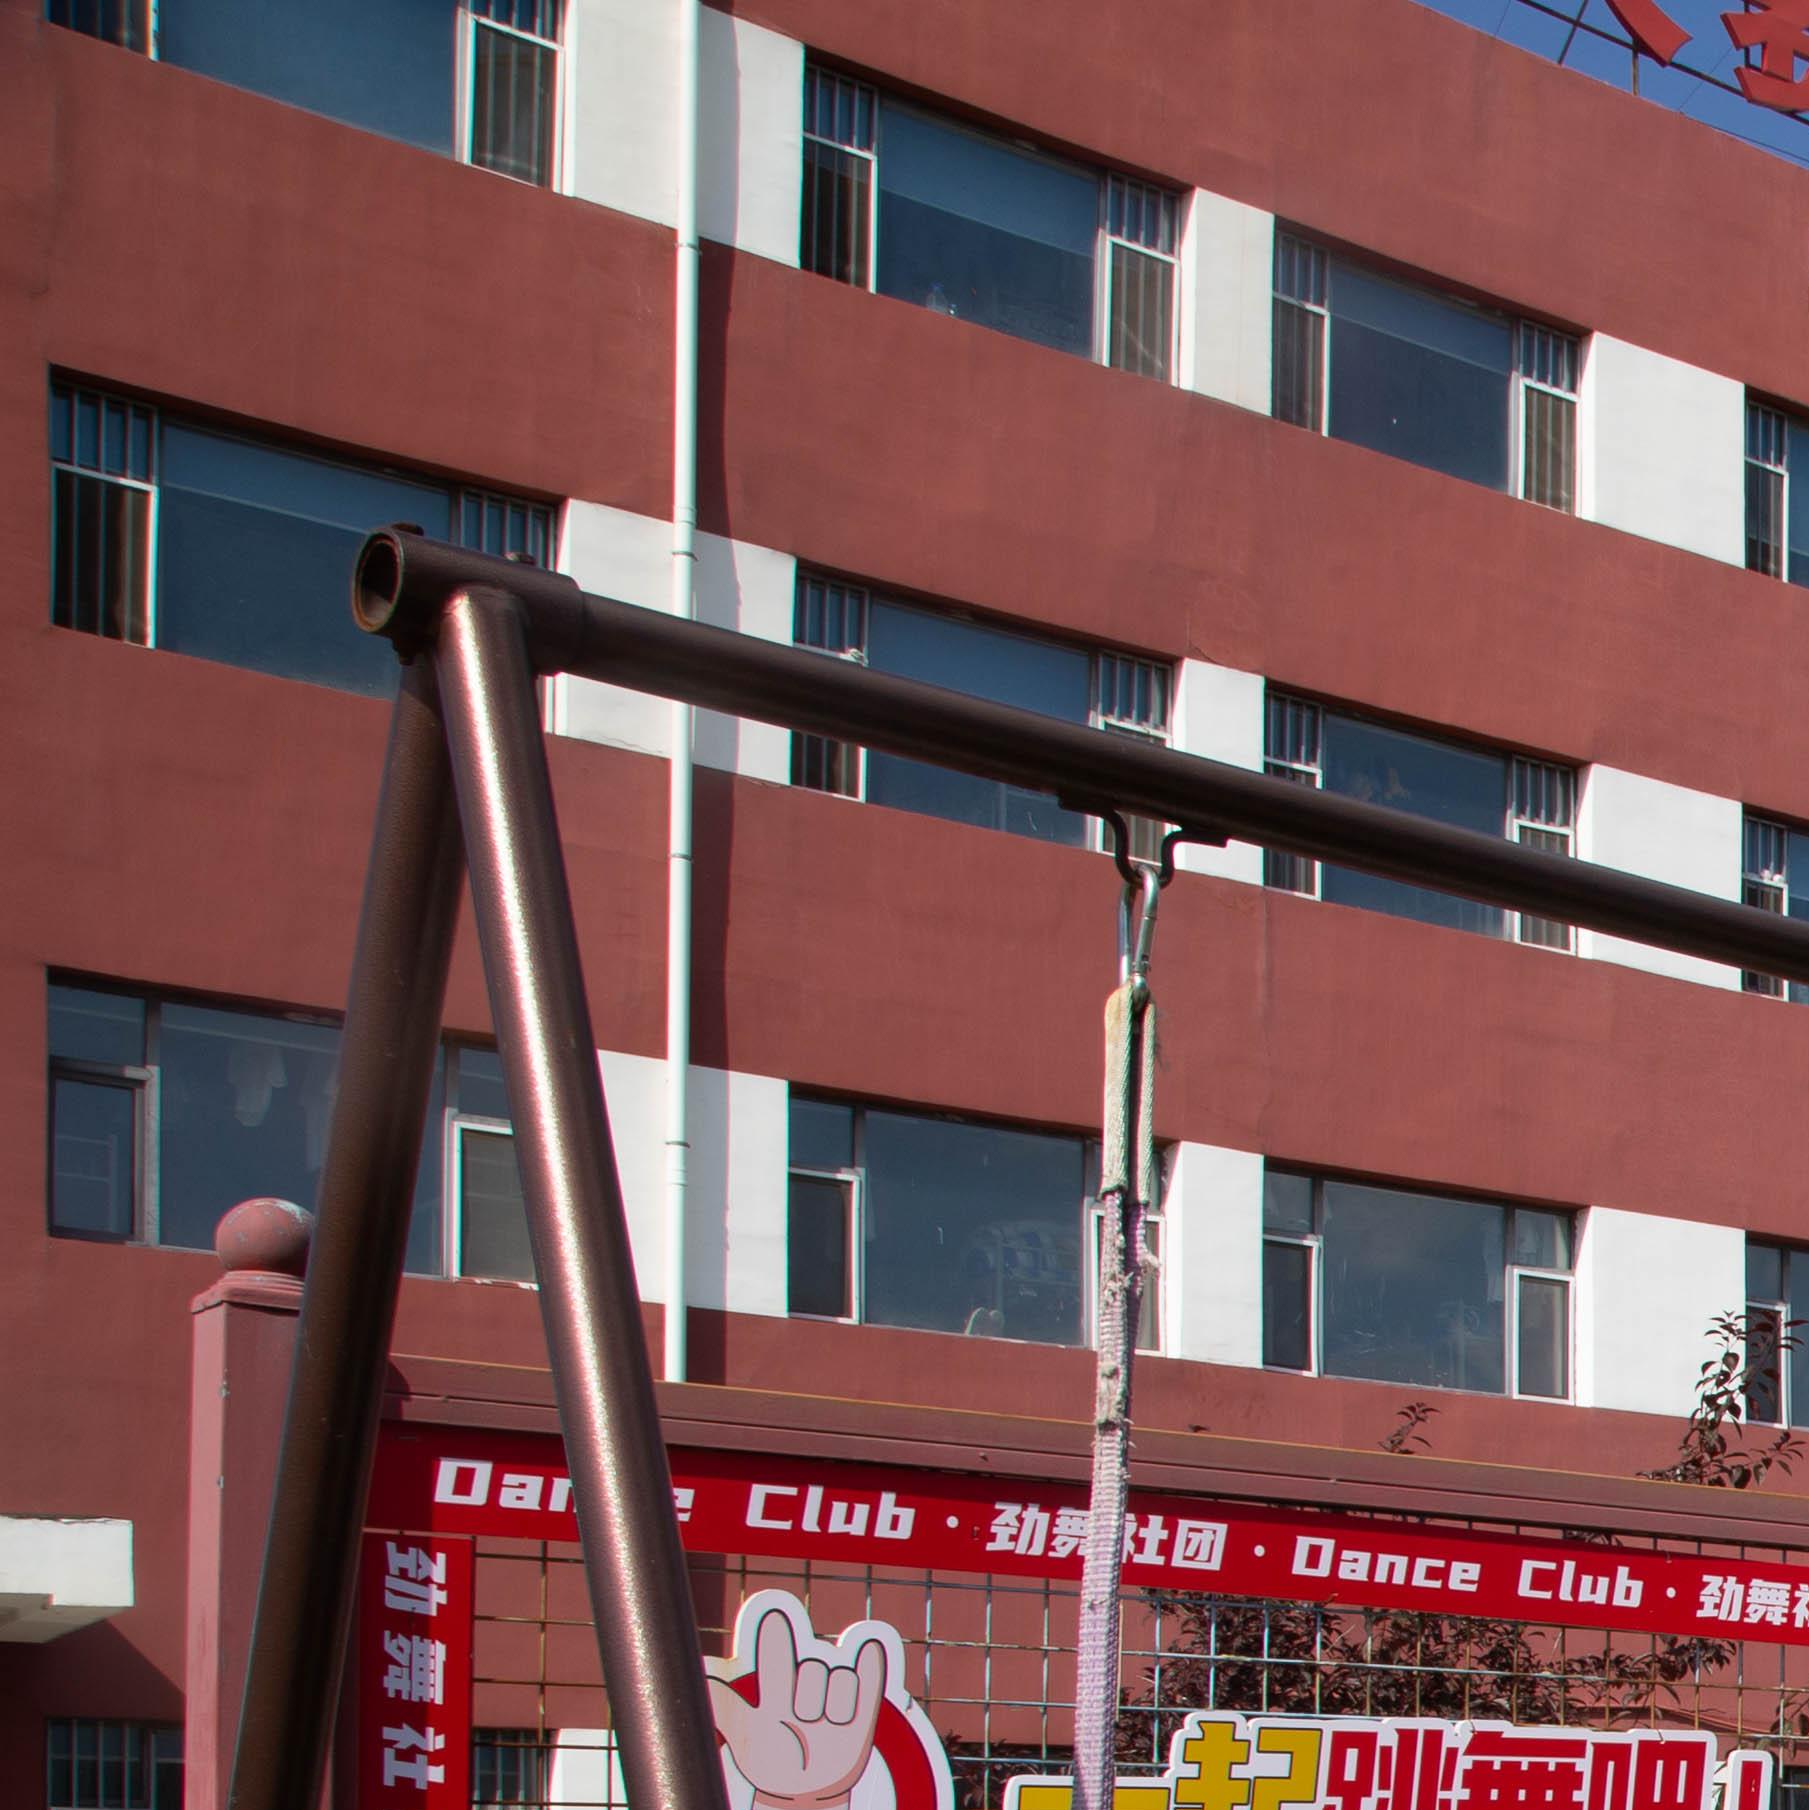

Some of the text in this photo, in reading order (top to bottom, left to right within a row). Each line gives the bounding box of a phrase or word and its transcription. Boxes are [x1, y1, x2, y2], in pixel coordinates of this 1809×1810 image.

[745, 1484, 916, 1540] Club
[1291, 1535, 1480, 1594] Dance
[1517, 1560, 1643, 1609] Club
